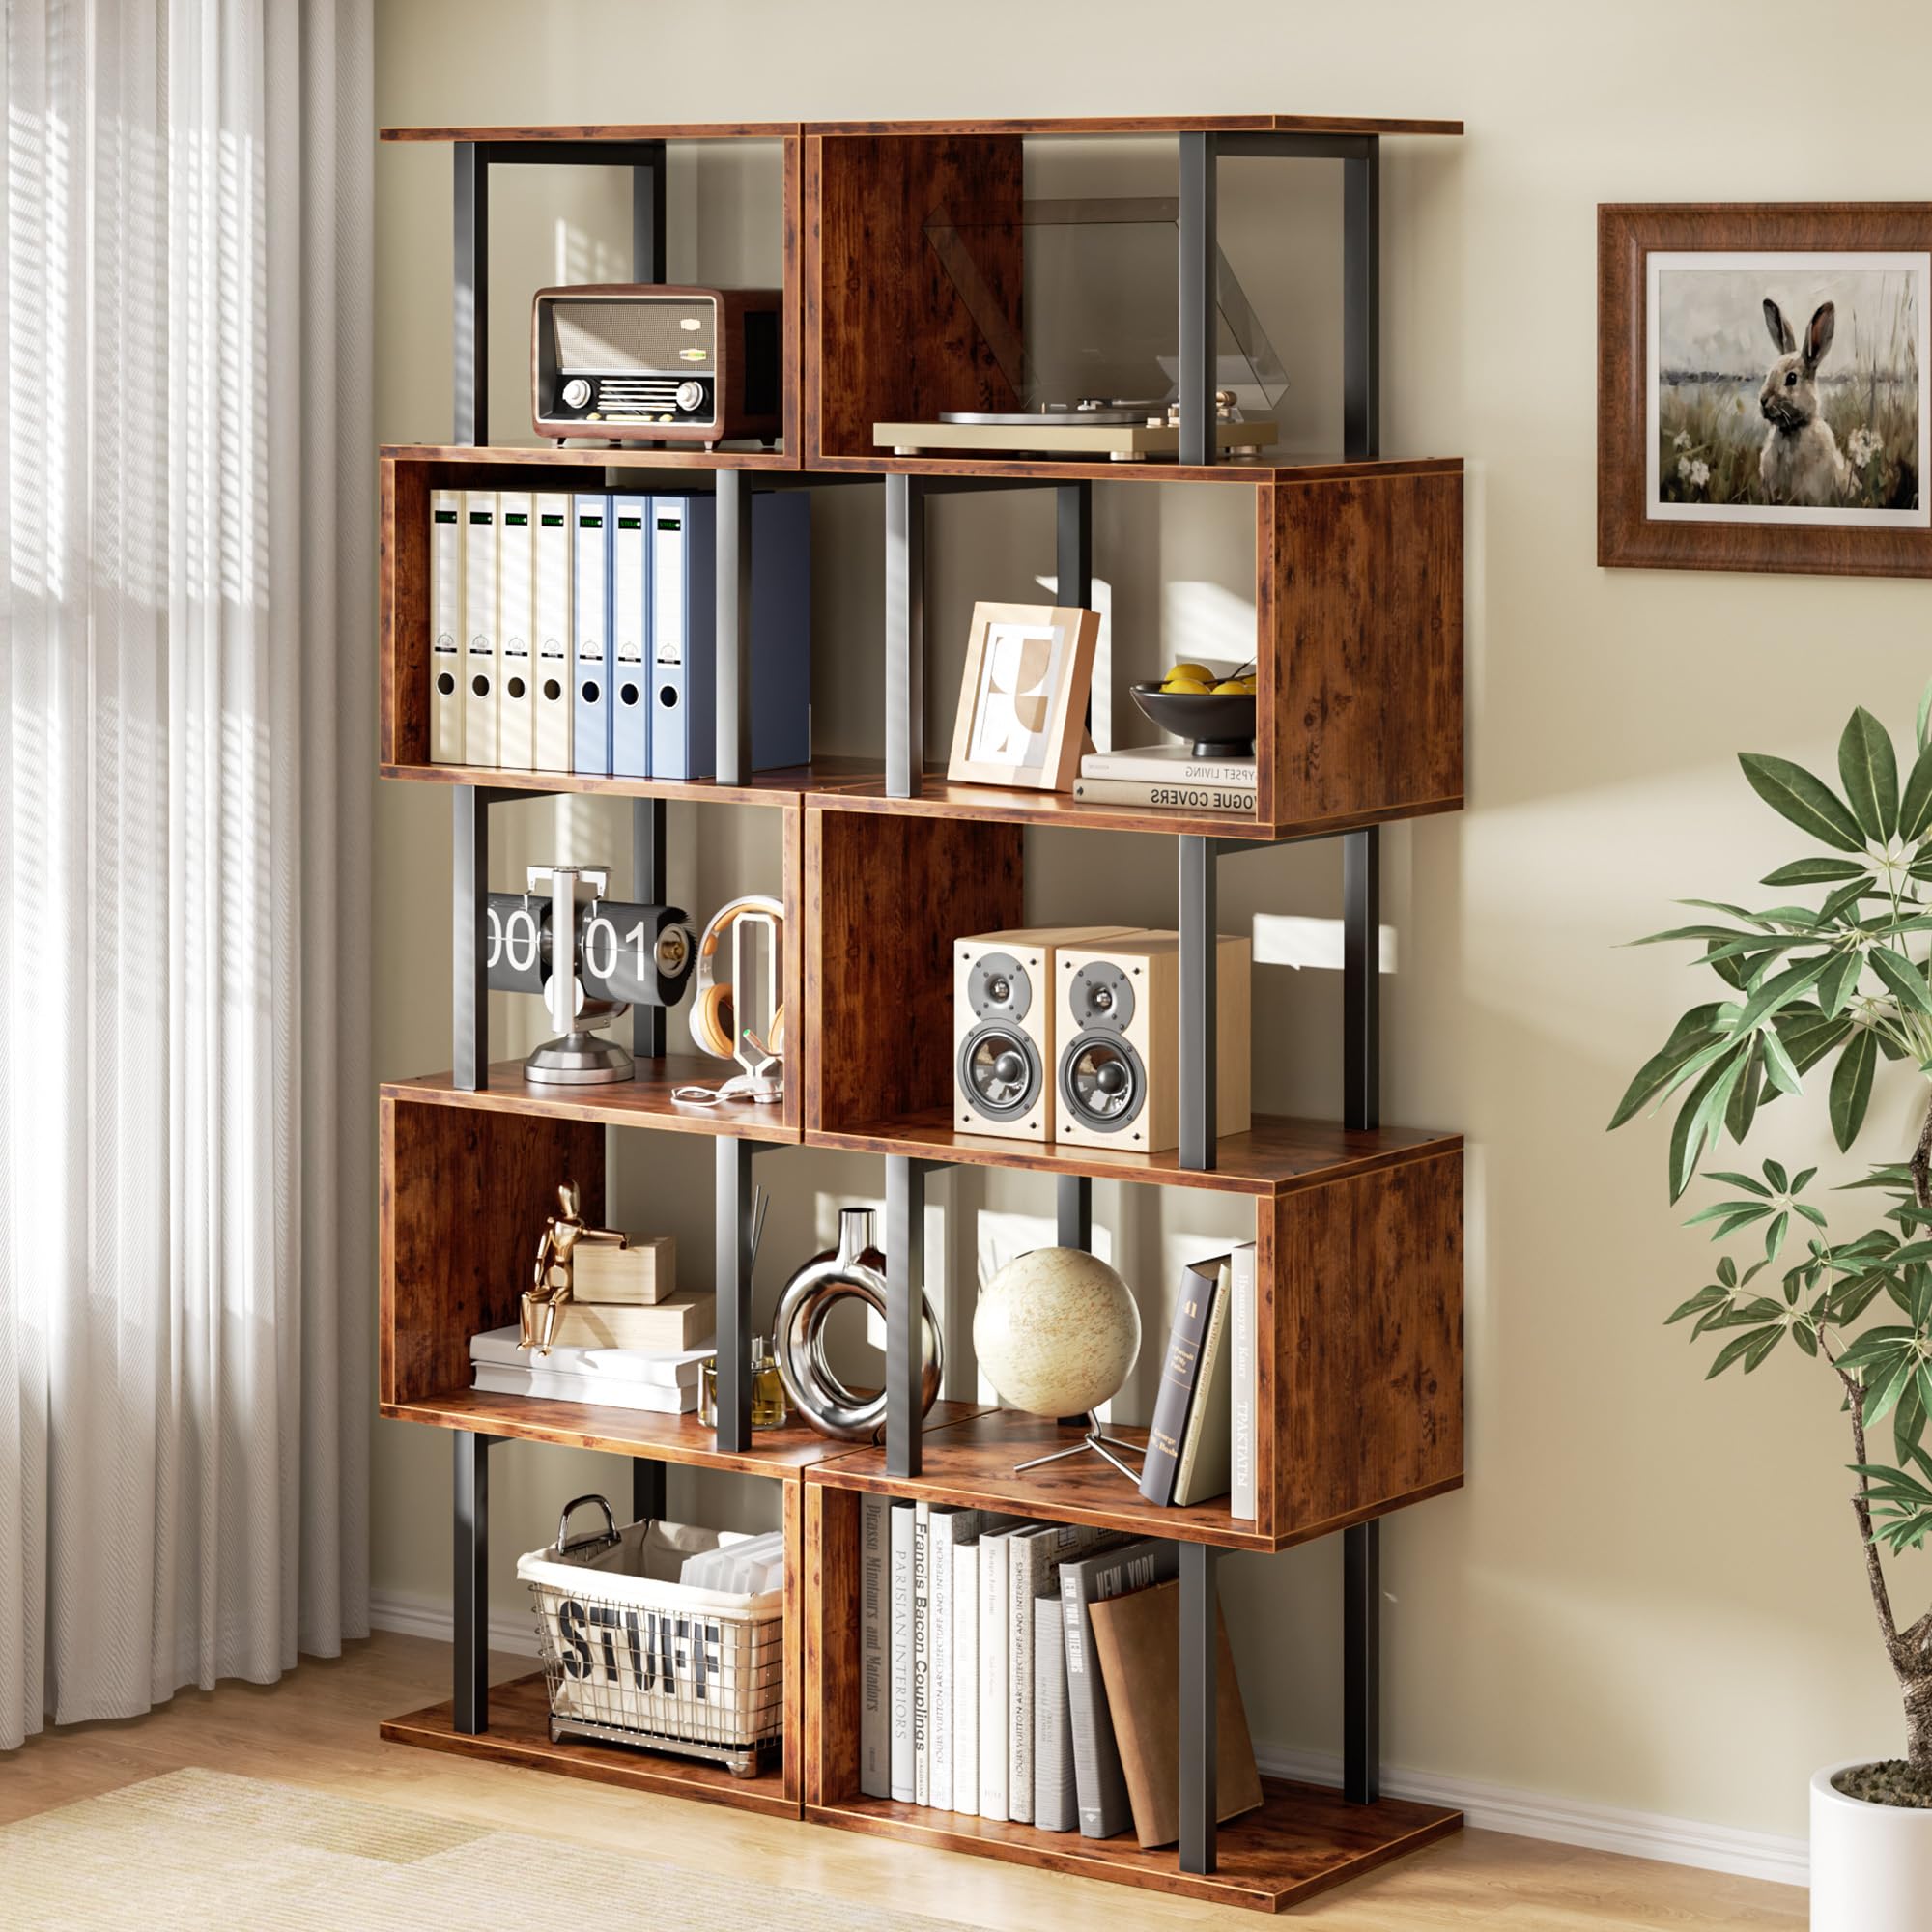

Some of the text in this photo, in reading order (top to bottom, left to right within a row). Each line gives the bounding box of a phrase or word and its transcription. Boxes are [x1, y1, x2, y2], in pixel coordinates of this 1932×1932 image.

[585, 918, 645, 981] 01
[1237, 1401, 1249, 1488] ТРАКТАТЫ
[558, 1600, 720, 1700] STUFF
[866, 1504, 881, 1712] Picasso Minotaurs and Matadors
[895, 1550, 907, 1739] PARISIAN INTERIORS
[915, 1523, 927, 1751] Francis Bacon Couplings
[935, 1539, 944, 1764] LOUIS VUITTON ARCHITECTURE AND INTERIORS
[1064, 1577, 1084, 1674] NEW YORK INTERIORS
[1095, 1565, 1122, 1601] NEW
[1015, 1561, 1024, 1777] LOUIS VUITTON ARCHITECTURE AND INTERIORS
